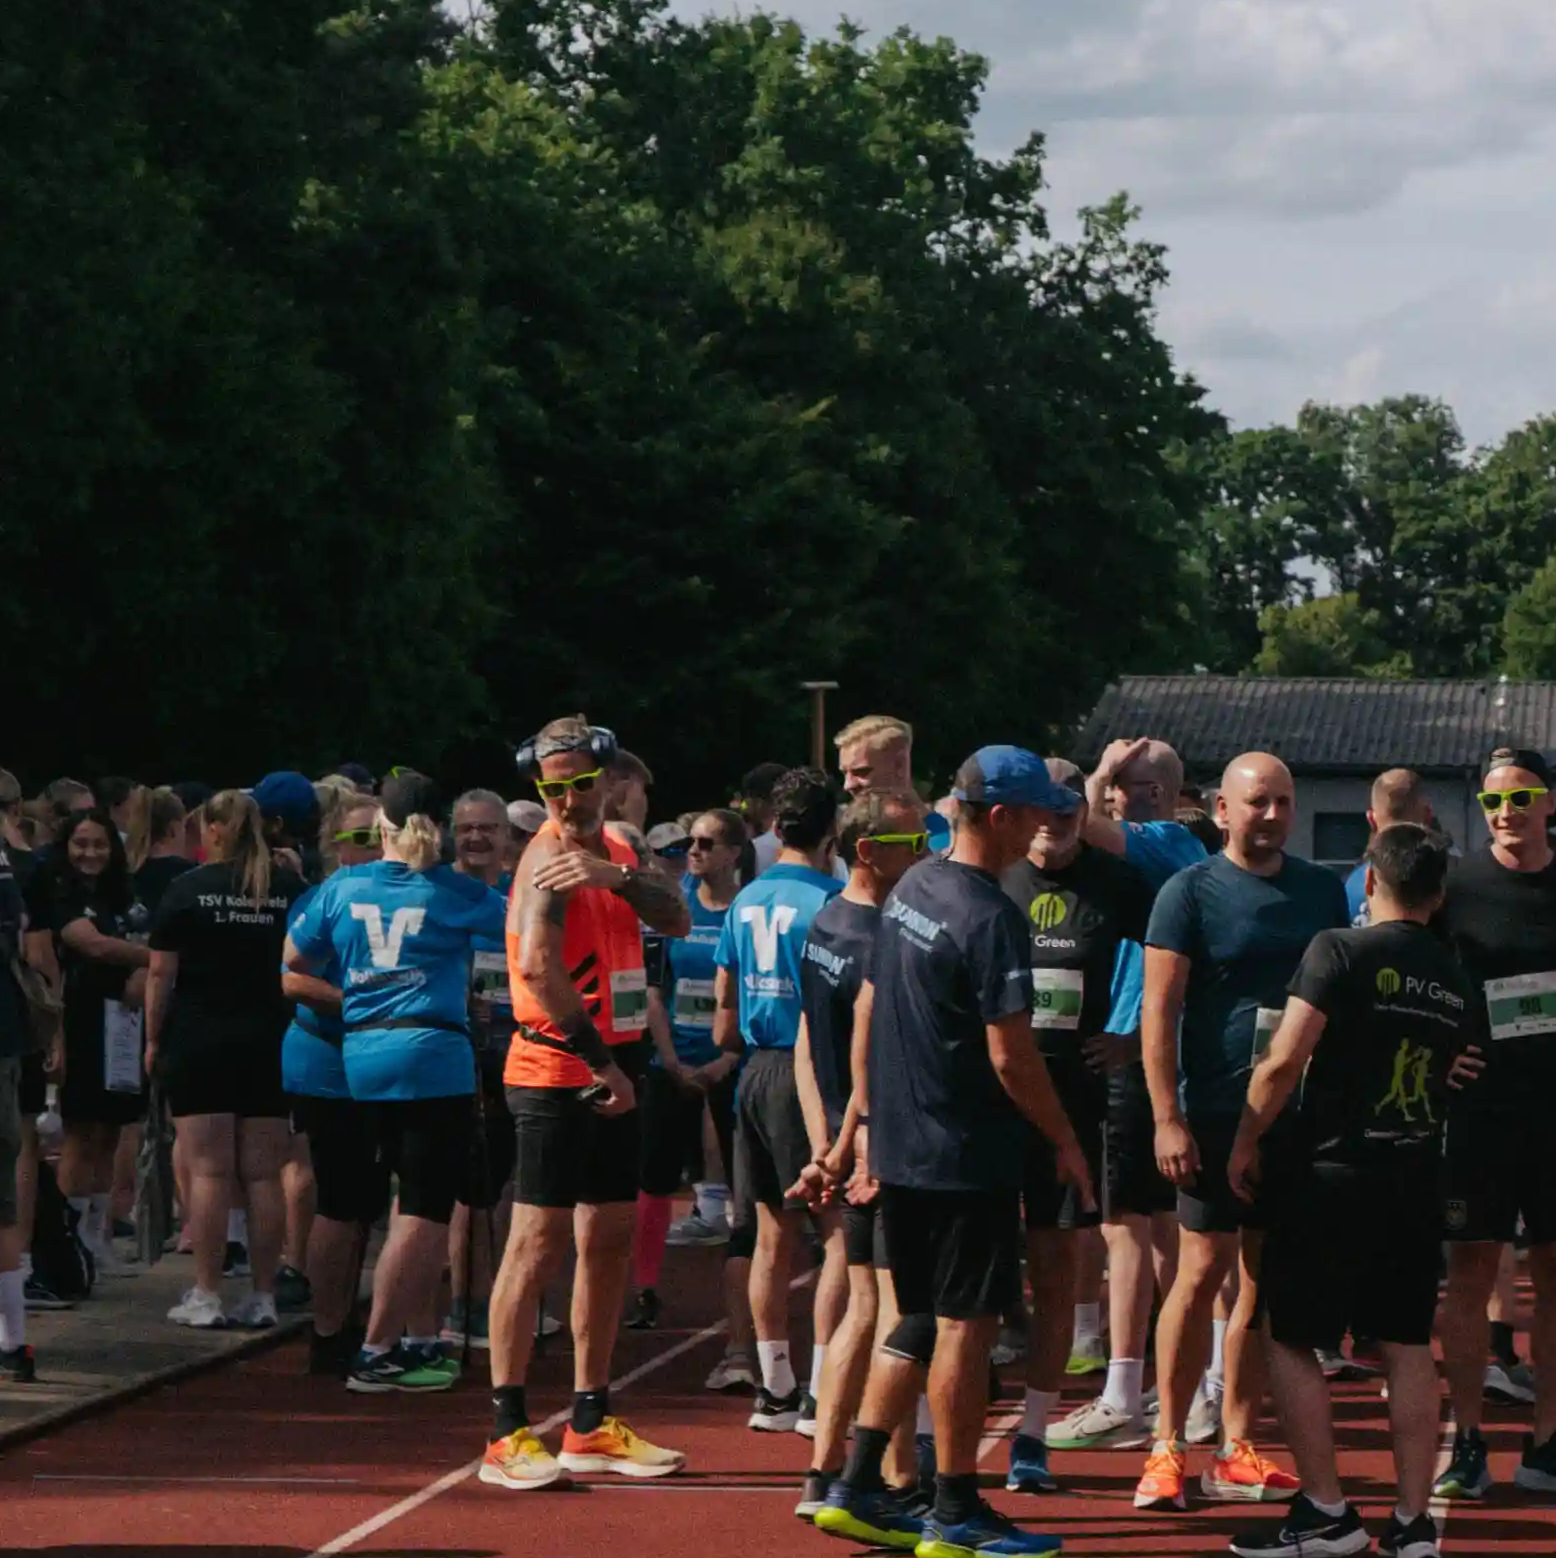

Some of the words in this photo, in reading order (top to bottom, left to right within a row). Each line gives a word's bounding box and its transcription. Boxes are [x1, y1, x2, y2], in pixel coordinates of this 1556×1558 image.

[196, 895, 223, 908] TSV
[214, 911, 227, 923] 1.
[228, 911, 274, 924] Frauen
[1034, 934, 1076, 948] Green
[1405, 976, 1427, 994] PV
[1428, 983, 1464, 1011] Green
